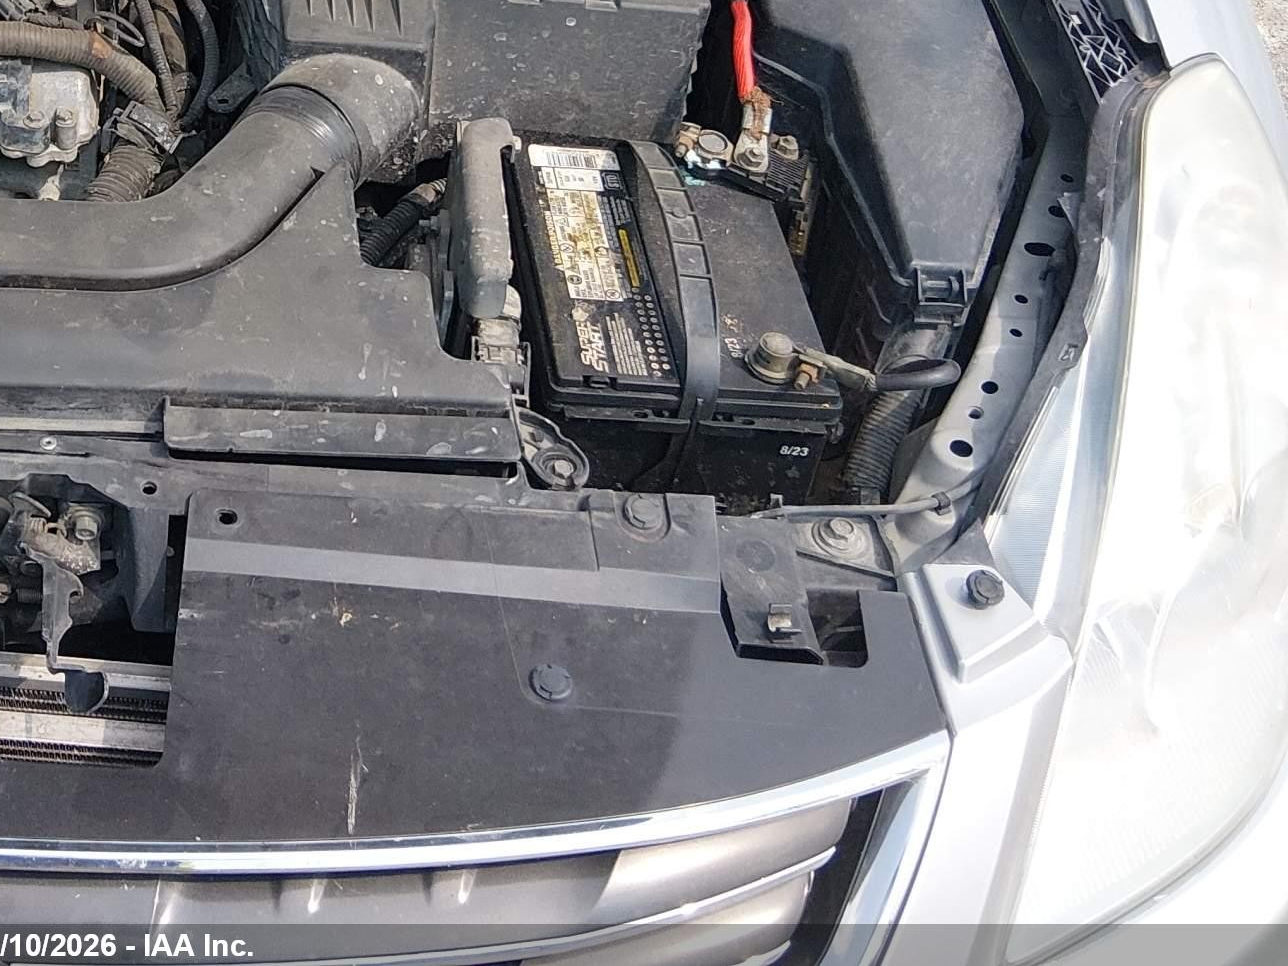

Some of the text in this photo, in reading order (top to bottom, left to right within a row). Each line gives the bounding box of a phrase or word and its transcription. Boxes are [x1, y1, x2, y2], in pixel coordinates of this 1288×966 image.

[576, 322, 593, 366] SUPER
[588, 323, 610, 373] START
[779, 445, 810, 457] 8/23
